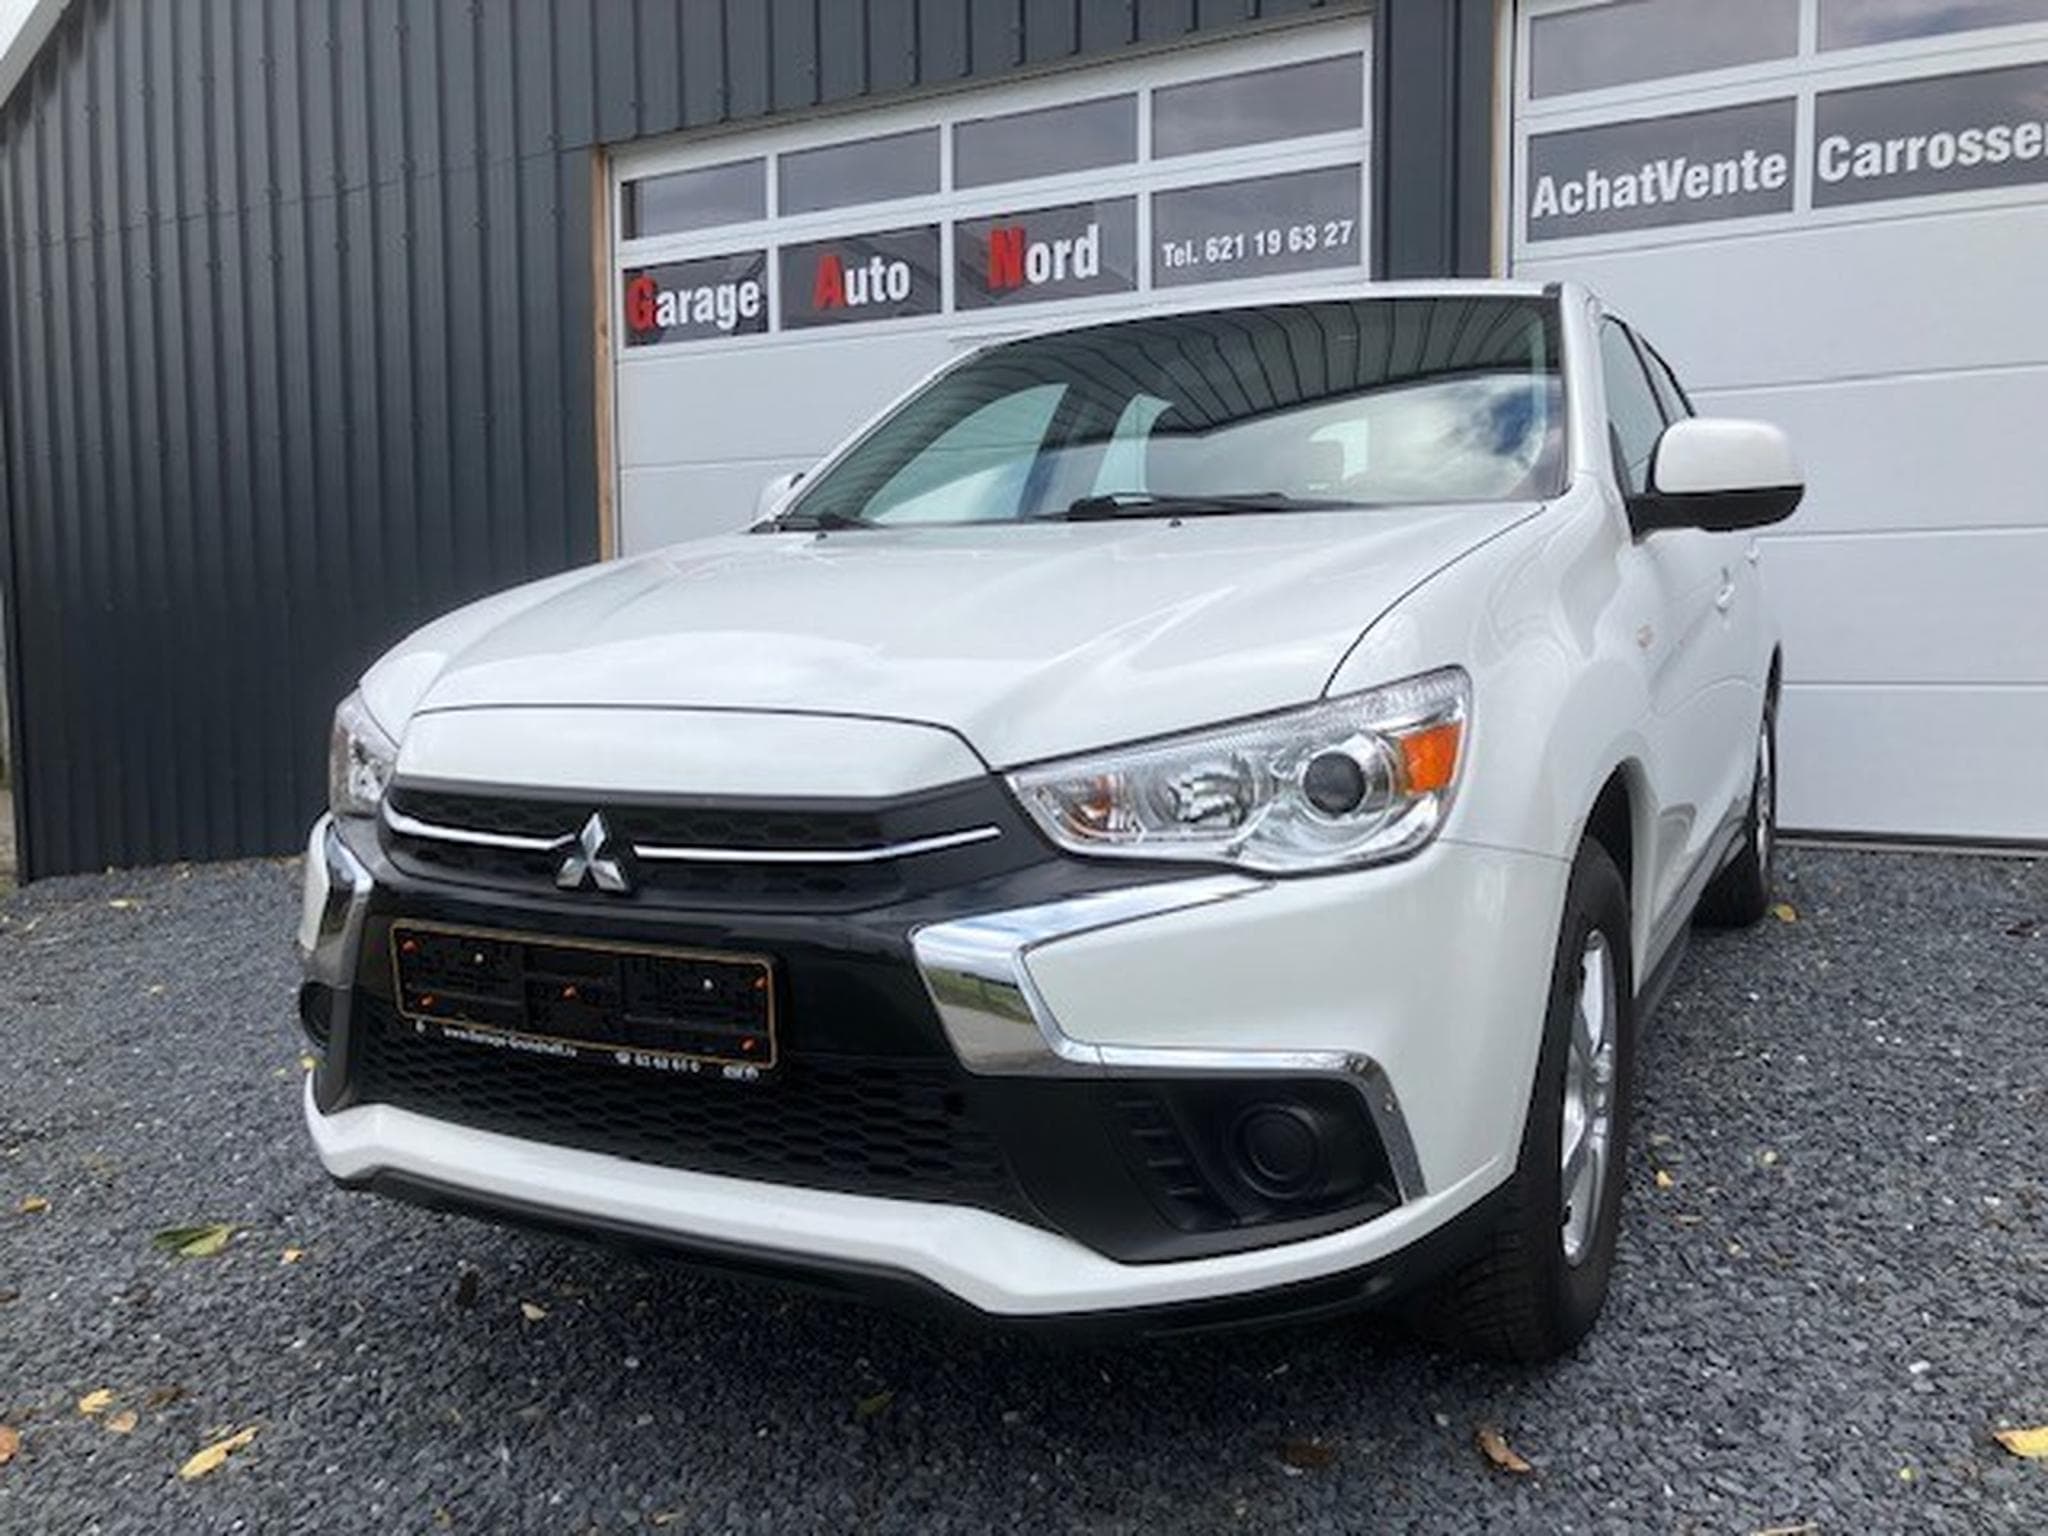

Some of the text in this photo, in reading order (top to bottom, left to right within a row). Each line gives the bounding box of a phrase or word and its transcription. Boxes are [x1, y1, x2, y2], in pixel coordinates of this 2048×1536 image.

[1531, 148, 1787, 218] AchatVente
[1817, 121, 2048, 183] Carrosse
[1162, 219, 1354, 267] Tel. 621 19 63 27
[629, 223, 1100, 331] Garage Auto Nord
